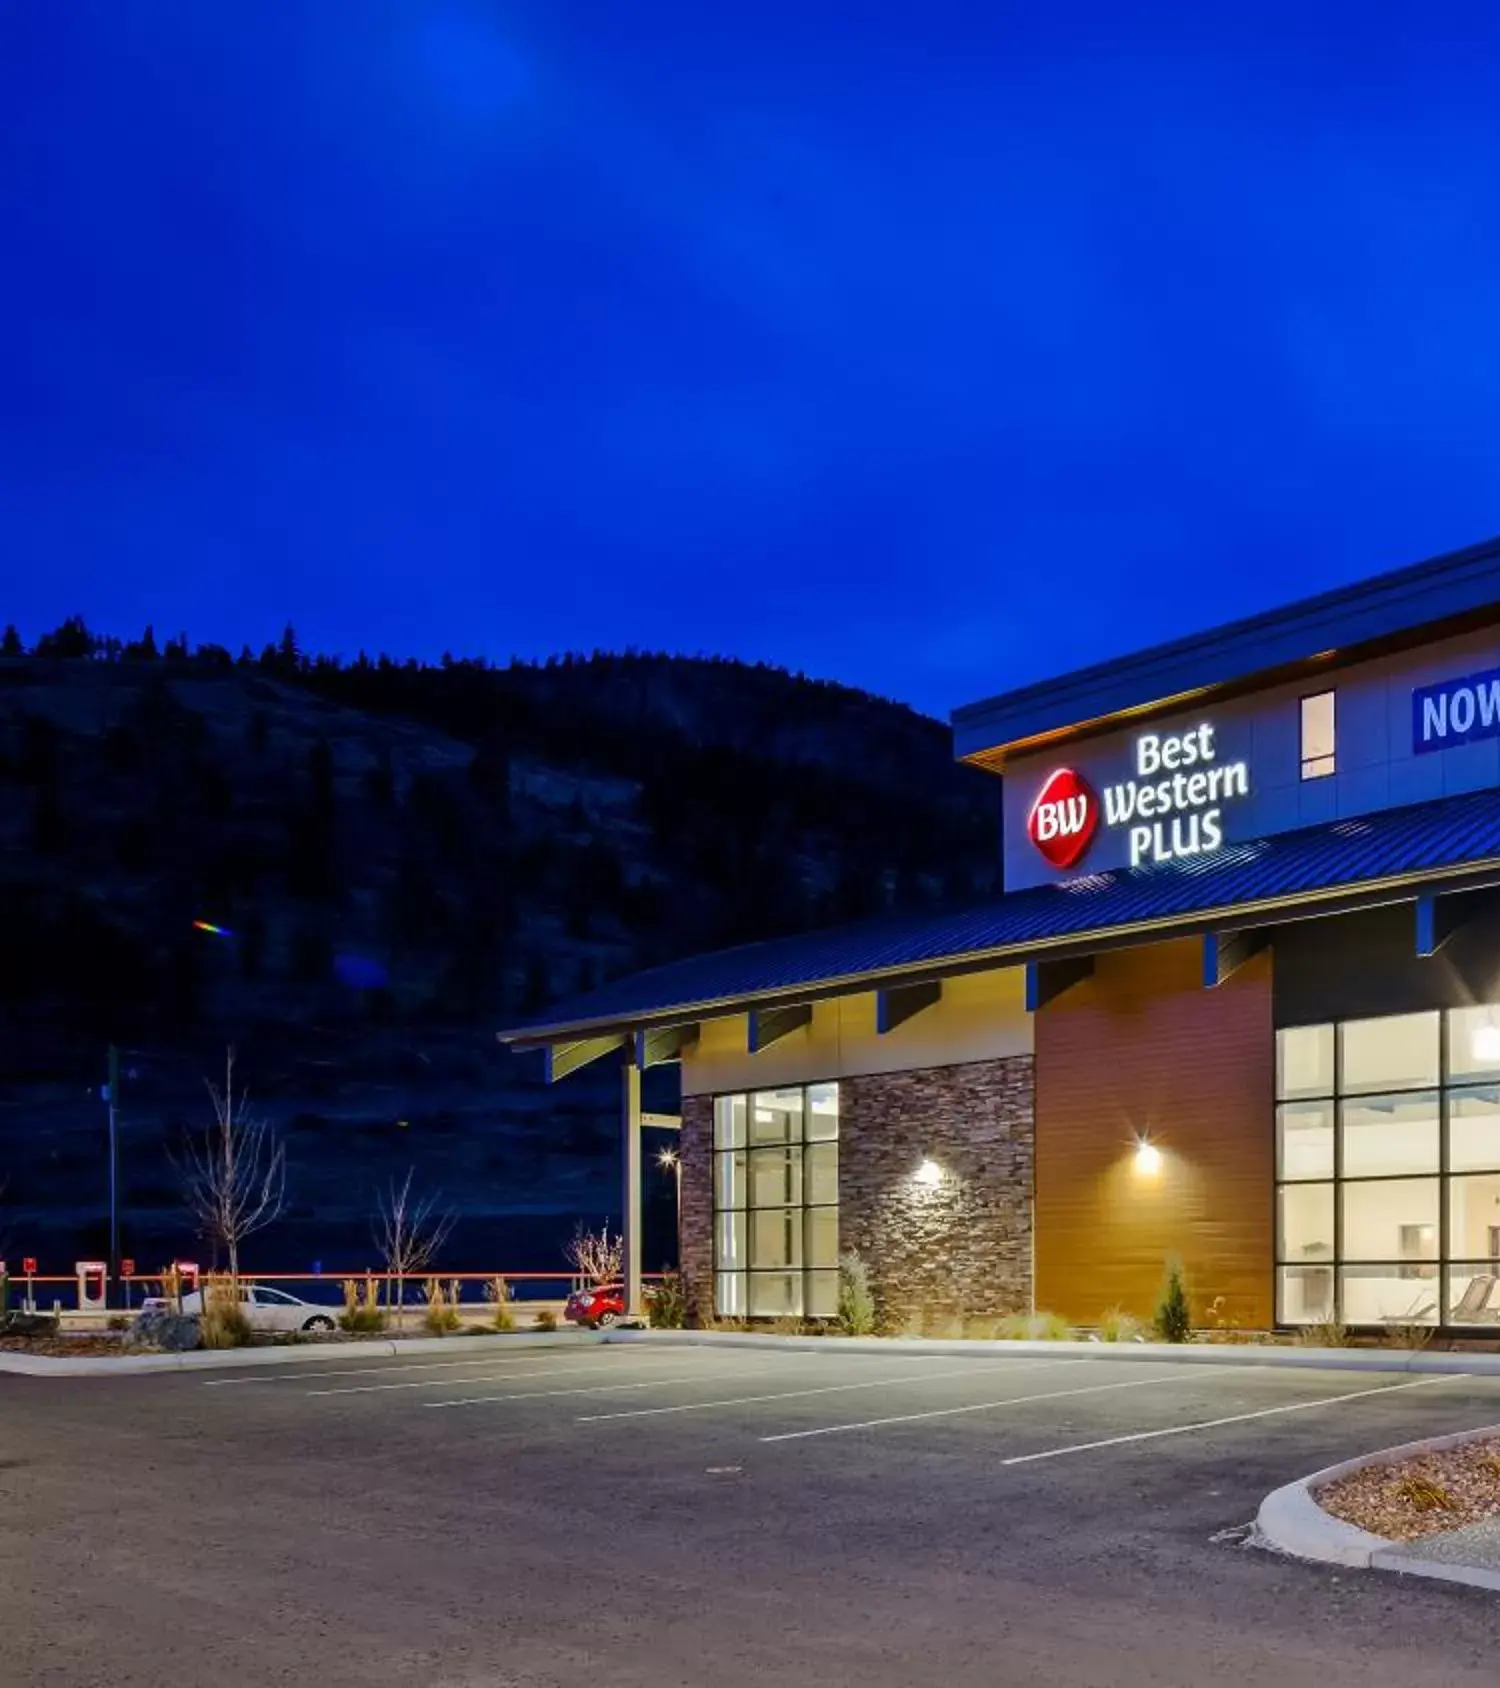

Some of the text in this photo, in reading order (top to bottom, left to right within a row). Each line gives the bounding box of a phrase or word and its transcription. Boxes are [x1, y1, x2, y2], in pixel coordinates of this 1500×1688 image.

[1136, 722, 1216, 776] Best
[1037, 793, 1088, 842] BW
[1103, 761, 1249, 826] Western
[1129, 808, 1223, 868] PLUS
